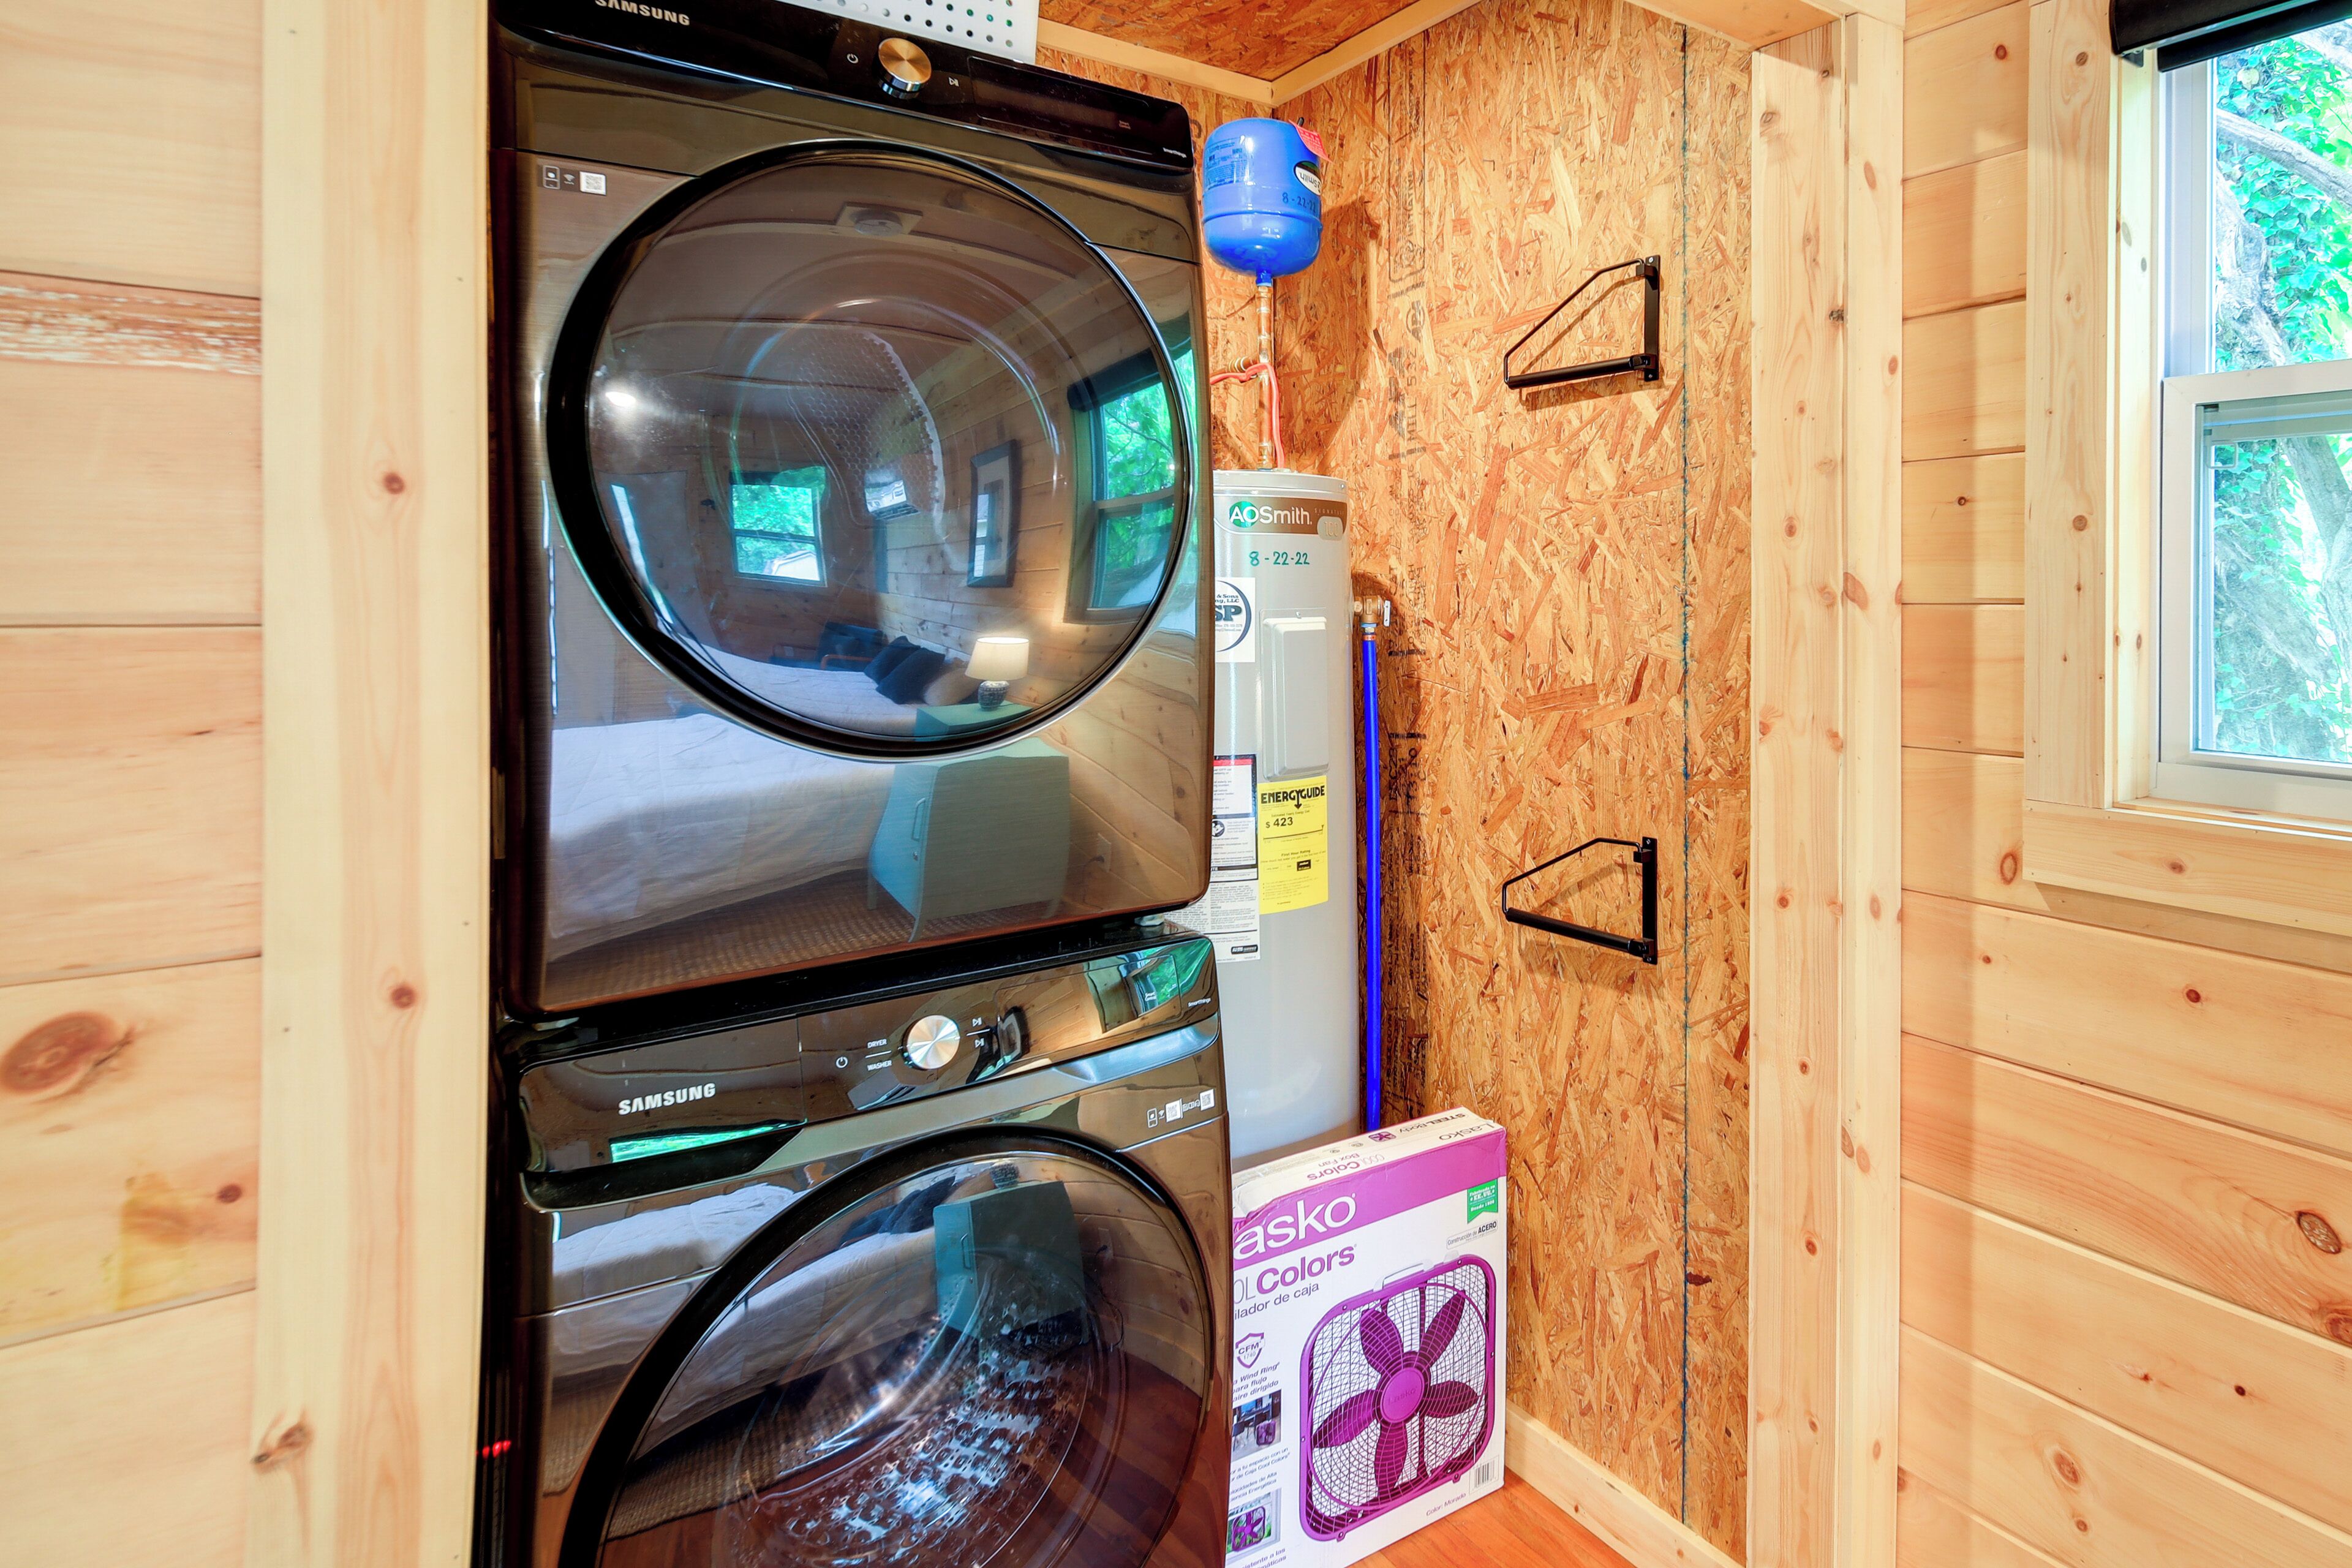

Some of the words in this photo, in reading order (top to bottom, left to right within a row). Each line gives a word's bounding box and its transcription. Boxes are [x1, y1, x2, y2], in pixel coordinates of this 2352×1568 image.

[595, 0, 690, 26] SAMSUNG
[1261, 785, 1325, 805] ENERGYGUIDE
[1273, 816, 1294, 827] 423
[867, 1039, 887, 1049] DRYER
[867, 1060, 892, 1071] WASHER
[619, 1083, 716, 1115] SAMSUNG
[1439, 1123, 1495, 1140] Lasko
[1478, 1221, 1497, 1234] ACERO
[1273, 1294, 1289, 1305] de
[1294, 1283, 1319, 1297] caja
[1238, 1342, 1259, 1354] CFM
[1240, 1371, 1259, 1382] Wind
[1260, 1365, 1278, 1376] Ring
[1250, 1380, 1279, 1395] dirigido
